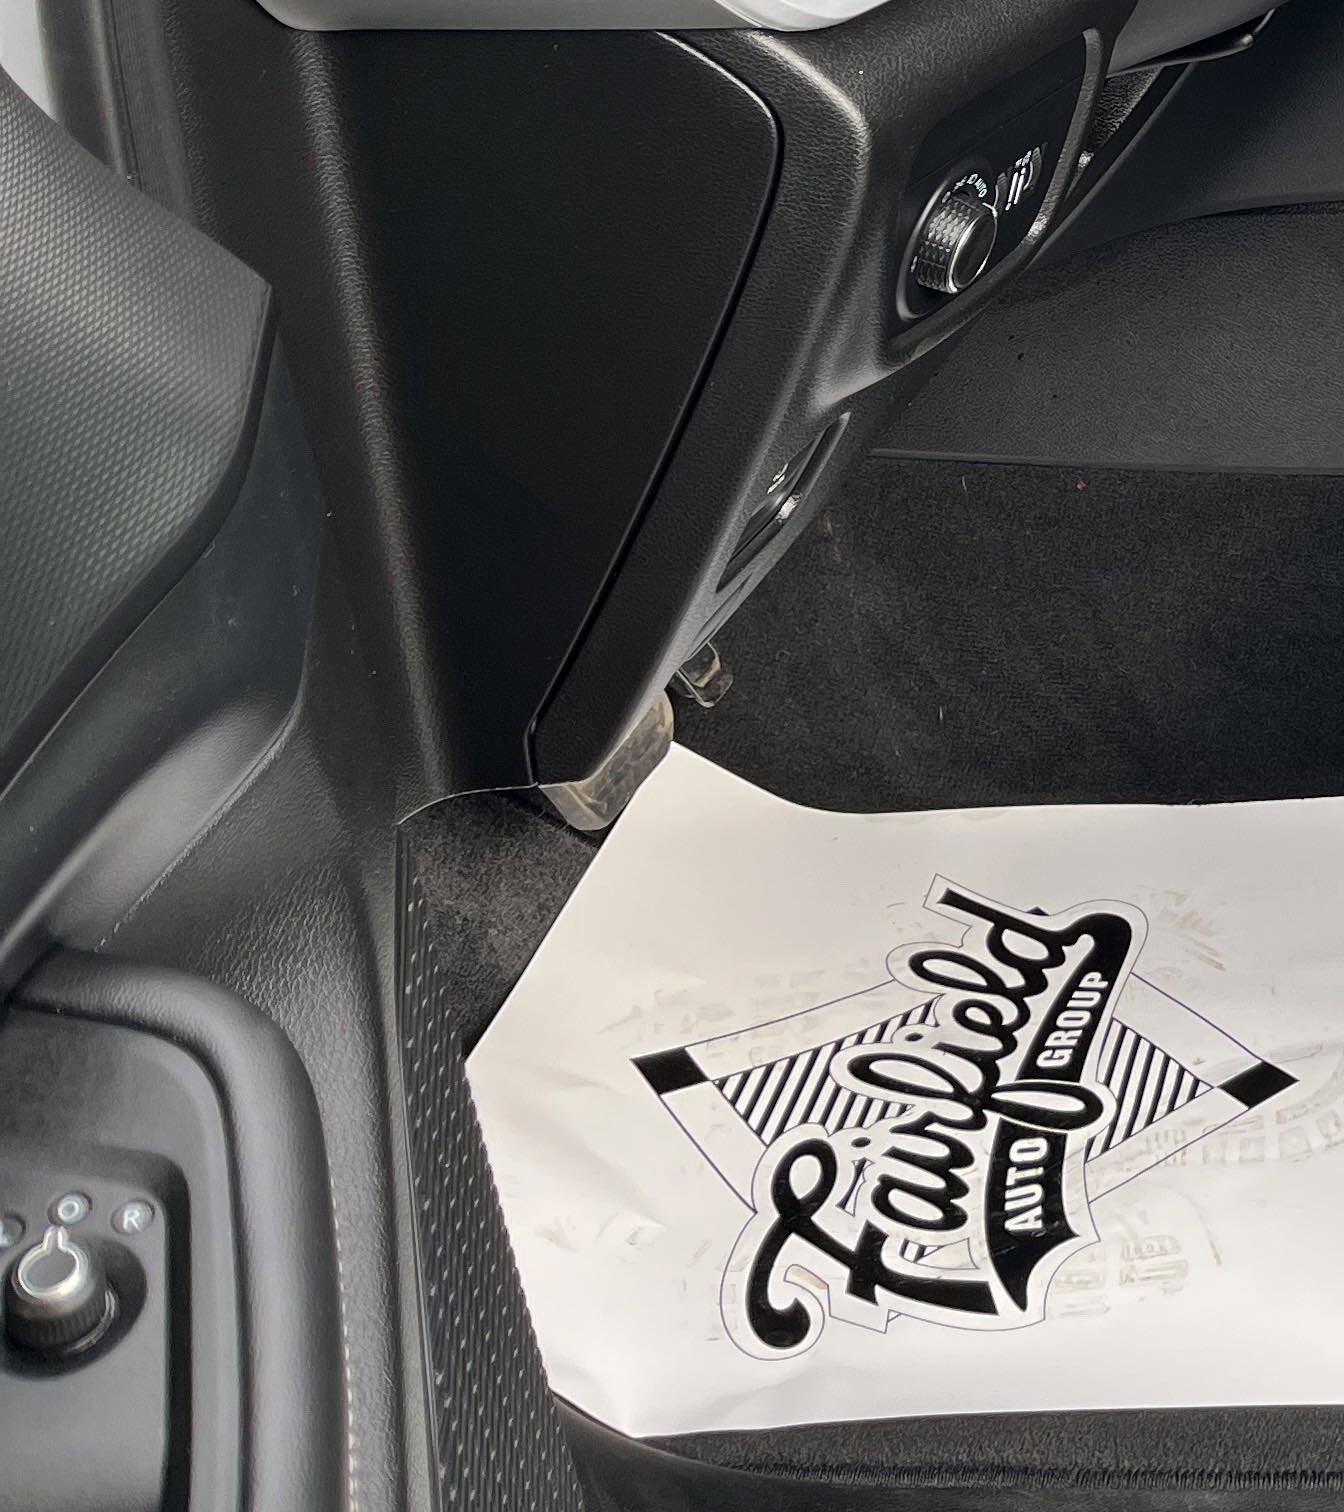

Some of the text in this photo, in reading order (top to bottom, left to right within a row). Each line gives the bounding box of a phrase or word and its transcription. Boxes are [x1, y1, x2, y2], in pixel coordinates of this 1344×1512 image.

[122, 1208, 143, 1233] R
[746, 887, 1112, 1351] Fairfield
[1005, 972, 1109, 1233] AUTO GROUP
